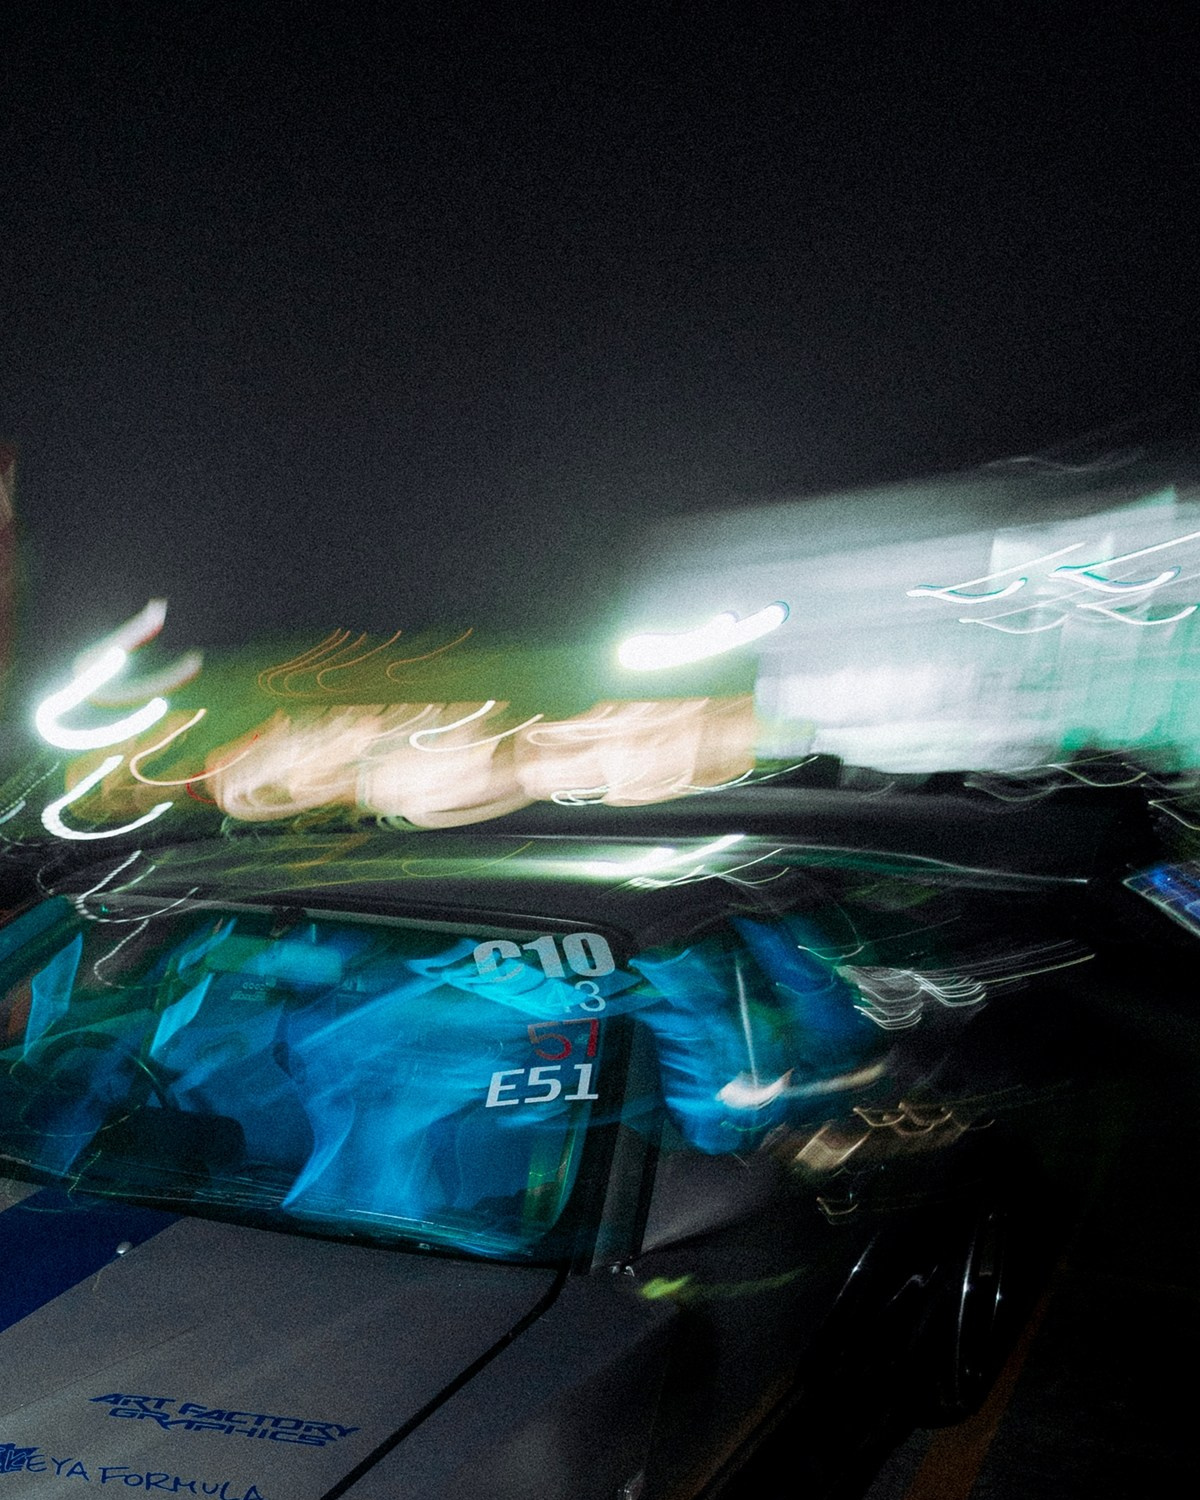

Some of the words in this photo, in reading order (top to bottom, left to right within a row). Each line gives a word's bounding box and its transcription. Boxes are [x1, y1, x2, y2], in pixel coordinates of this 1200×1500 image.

[527, 1017, 599, 1060] 57
[485, 1063, 599, 1108] E51
[88, 1393, 176, 1406] ART
[179, 1398, 361, 1440] FACTORY
[109, 1408, 328, 1447] GRAPHICS
